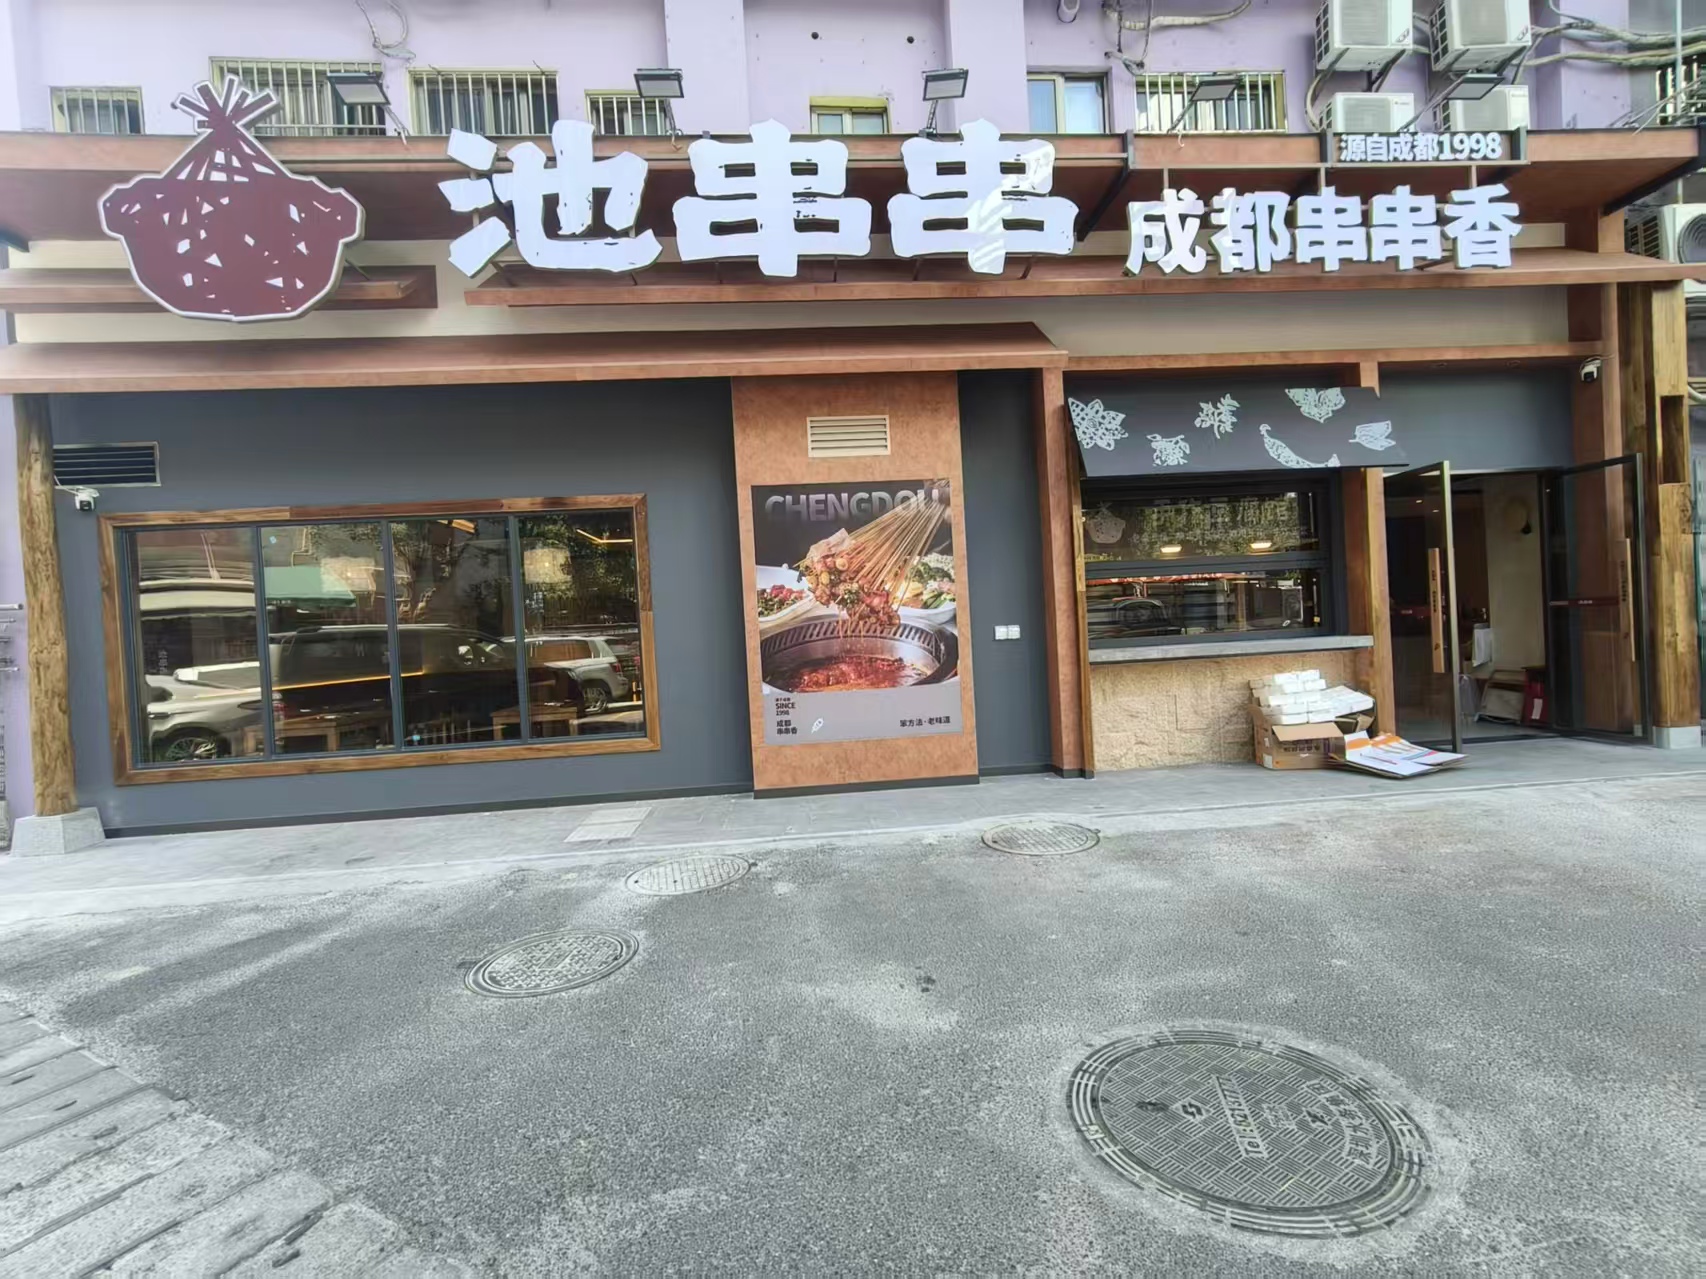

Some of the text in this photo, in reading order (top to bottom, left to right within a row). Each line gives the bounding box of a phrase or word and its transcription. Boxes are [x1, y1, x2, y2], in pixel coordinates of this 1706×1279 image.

[1339, 132, 1503, 163] 源自成都1998
[437, 118, 1079, 277] 池串串
[1125, 183, 1522, 276] 成都串串香
[775, 702, 796, 710] SINCE
